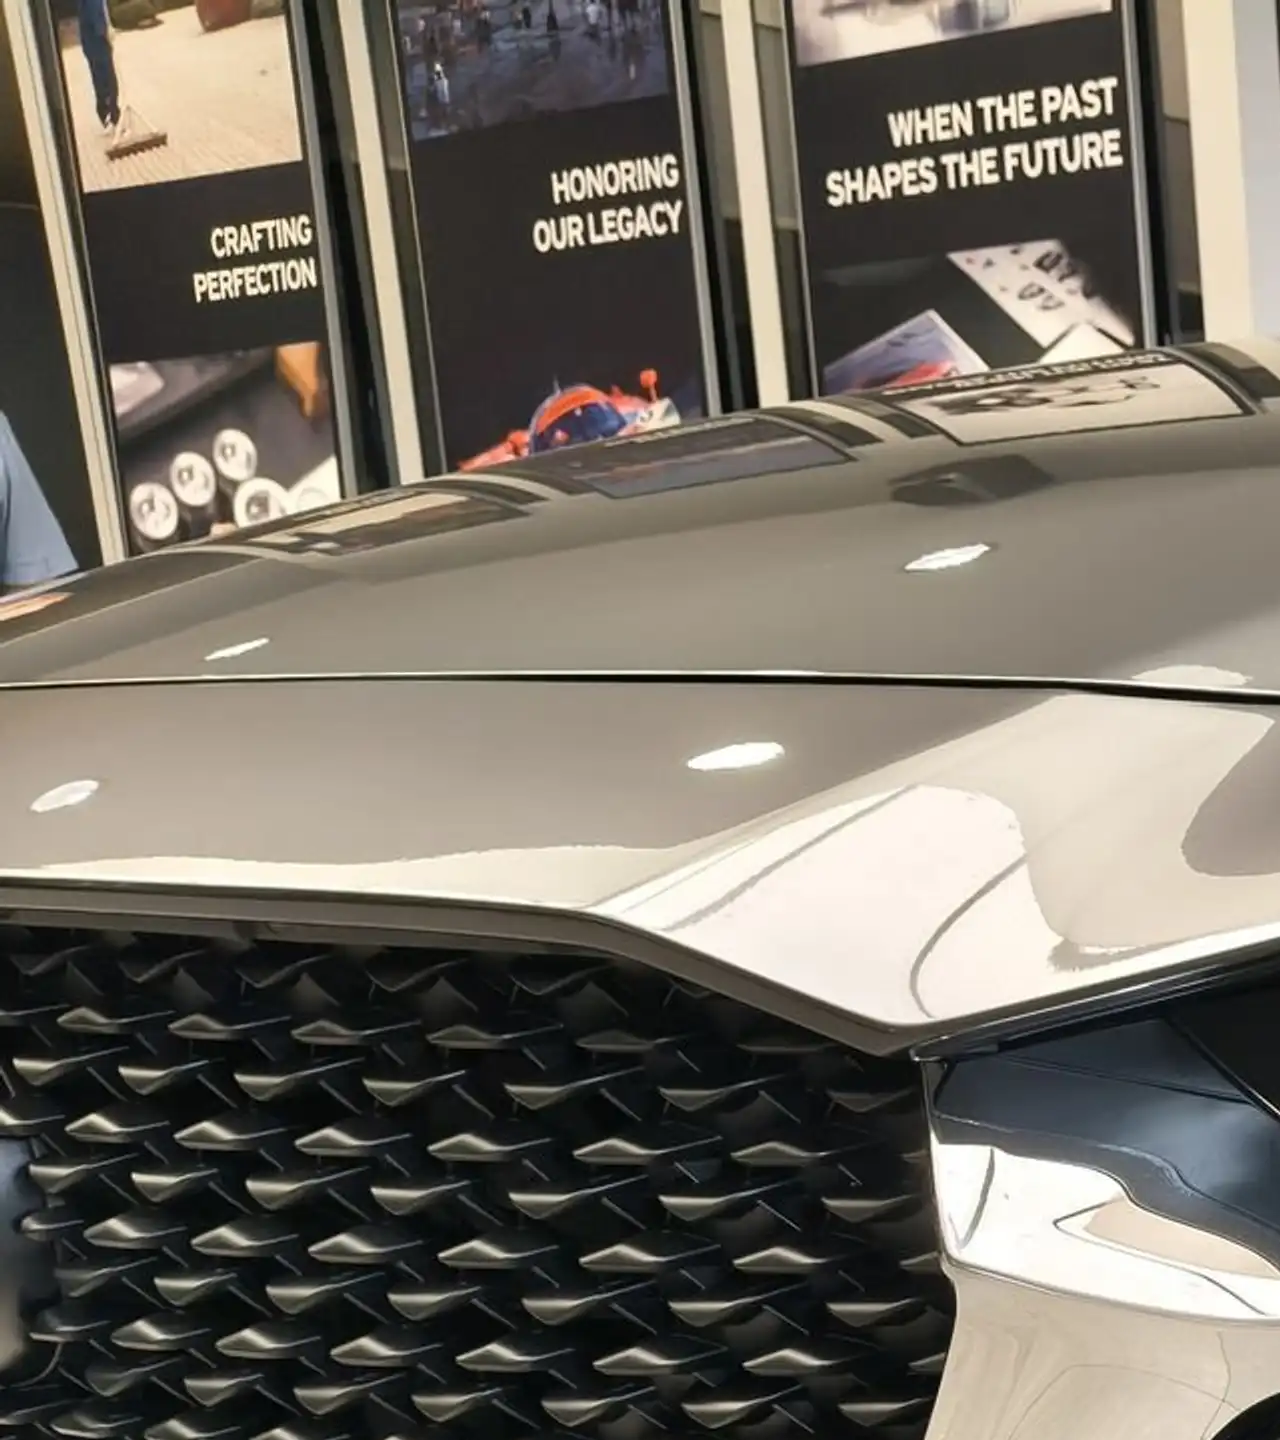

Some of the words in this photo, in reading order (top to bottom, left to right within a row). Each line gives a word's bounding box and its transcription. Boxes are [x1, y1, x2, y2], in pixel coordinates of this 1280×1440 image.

[888, 101, 974, 147] WHEN
[976, 90, 1038, 133] THE
[1041, 76, 1119, 124] PAST
[551, 153, 680, 205] HONORING
[826, 157, 938, 207] SHAPES
[941, 147, 1000, 189] THE
[1003, 128, 1123, 181] FUTURE
[210, 214, 313, 258] CRAFTING
[532, 214, 586, 253] OUR
[587, 199, 683, 244] LEGACY
[192, 256, 317, 303] PERFECTION
